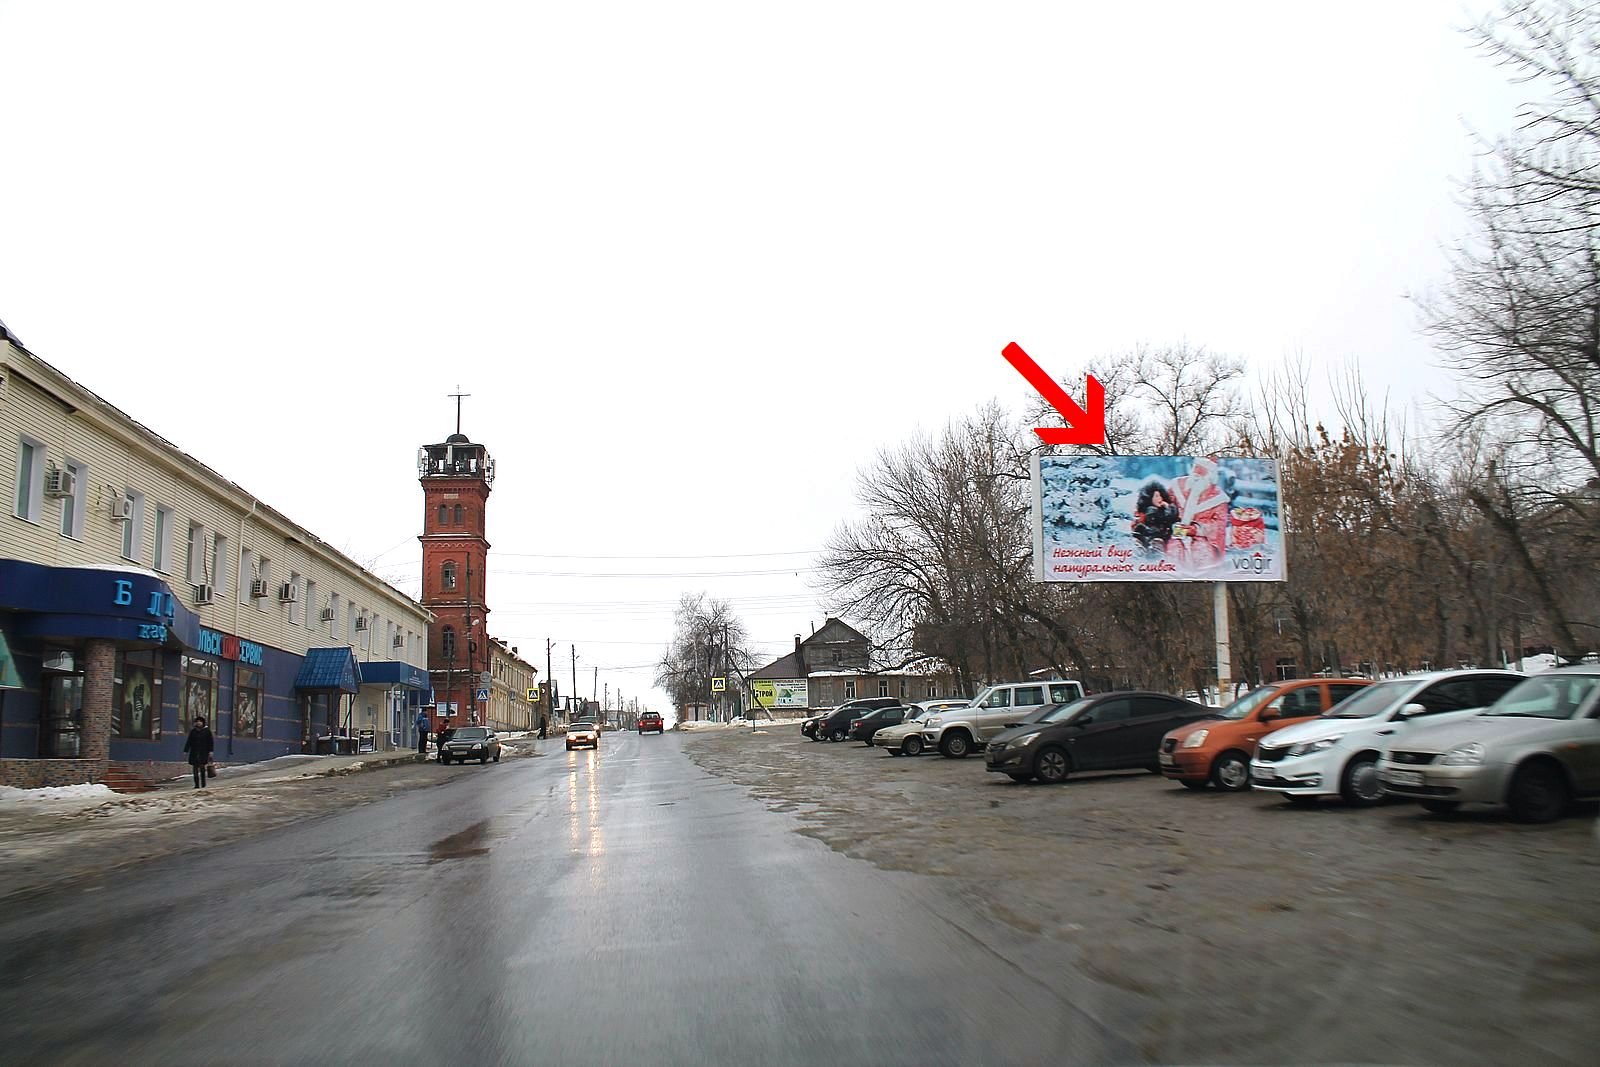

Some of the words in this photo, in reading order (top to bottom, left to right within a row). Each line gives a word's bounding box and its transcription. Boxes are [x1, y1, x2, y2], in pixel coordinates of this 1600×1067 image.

[1053, 546, 1102, 558] Нежный
[1107, 545, 1133, 563] вкус
[1053, 563, 1134, 578] натуральных
[1138, 560, 1177, 573] сливок
[1232, 553, 1272, 574] volgir
